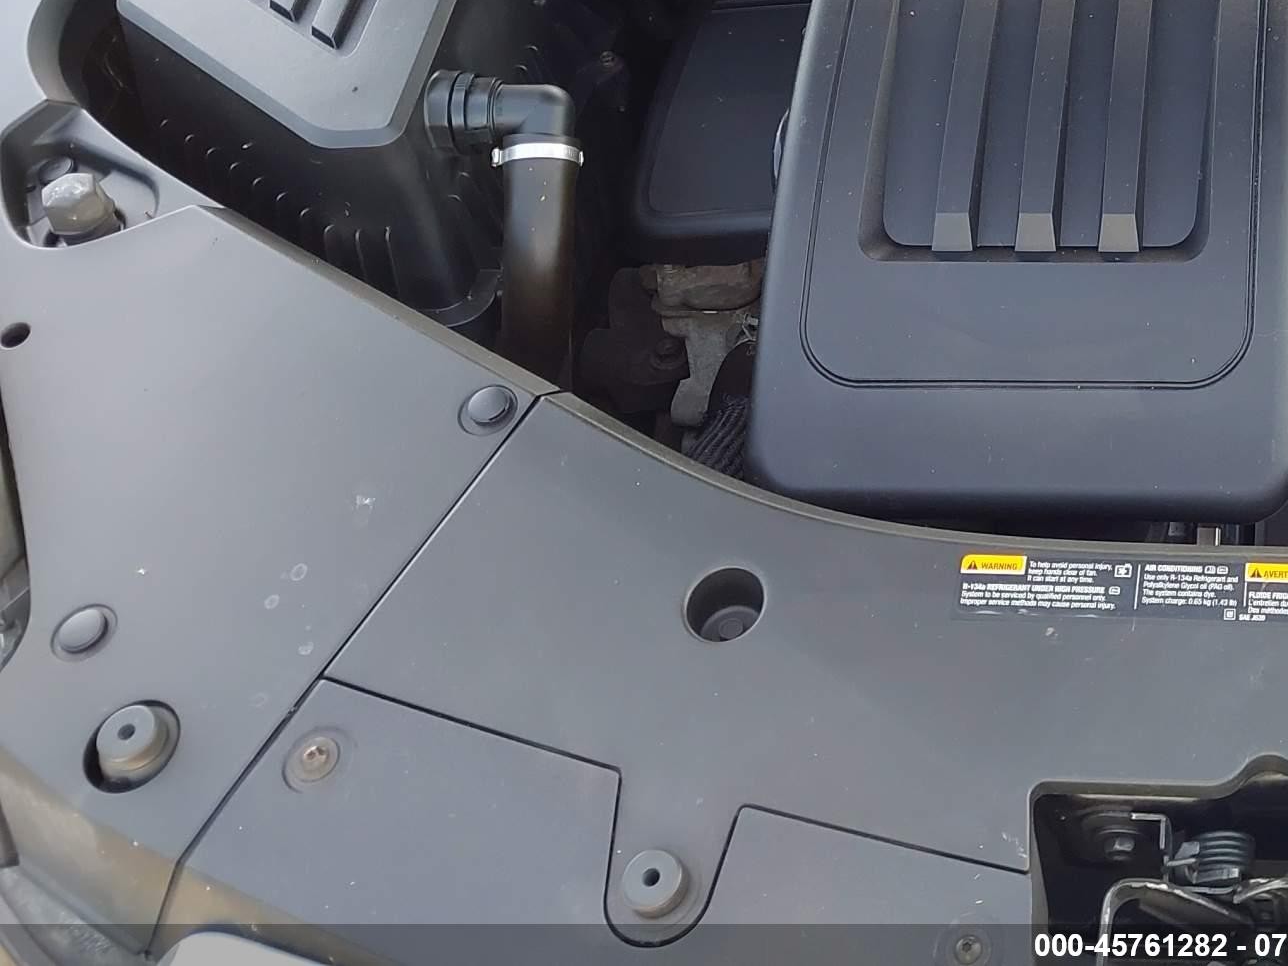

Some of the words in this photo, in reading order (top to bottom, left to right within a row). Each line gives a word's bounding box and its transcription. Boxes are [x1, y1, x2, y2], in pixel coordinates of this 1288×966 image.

[981, 562, 1017, 570] WARNING
[1038, 561, 1050, 569] help
[1068, 562, 1094, 571] personal
[1157, 565, 1203, 573] CONDITIONING
[1029, 568, 1043, 576] keep
